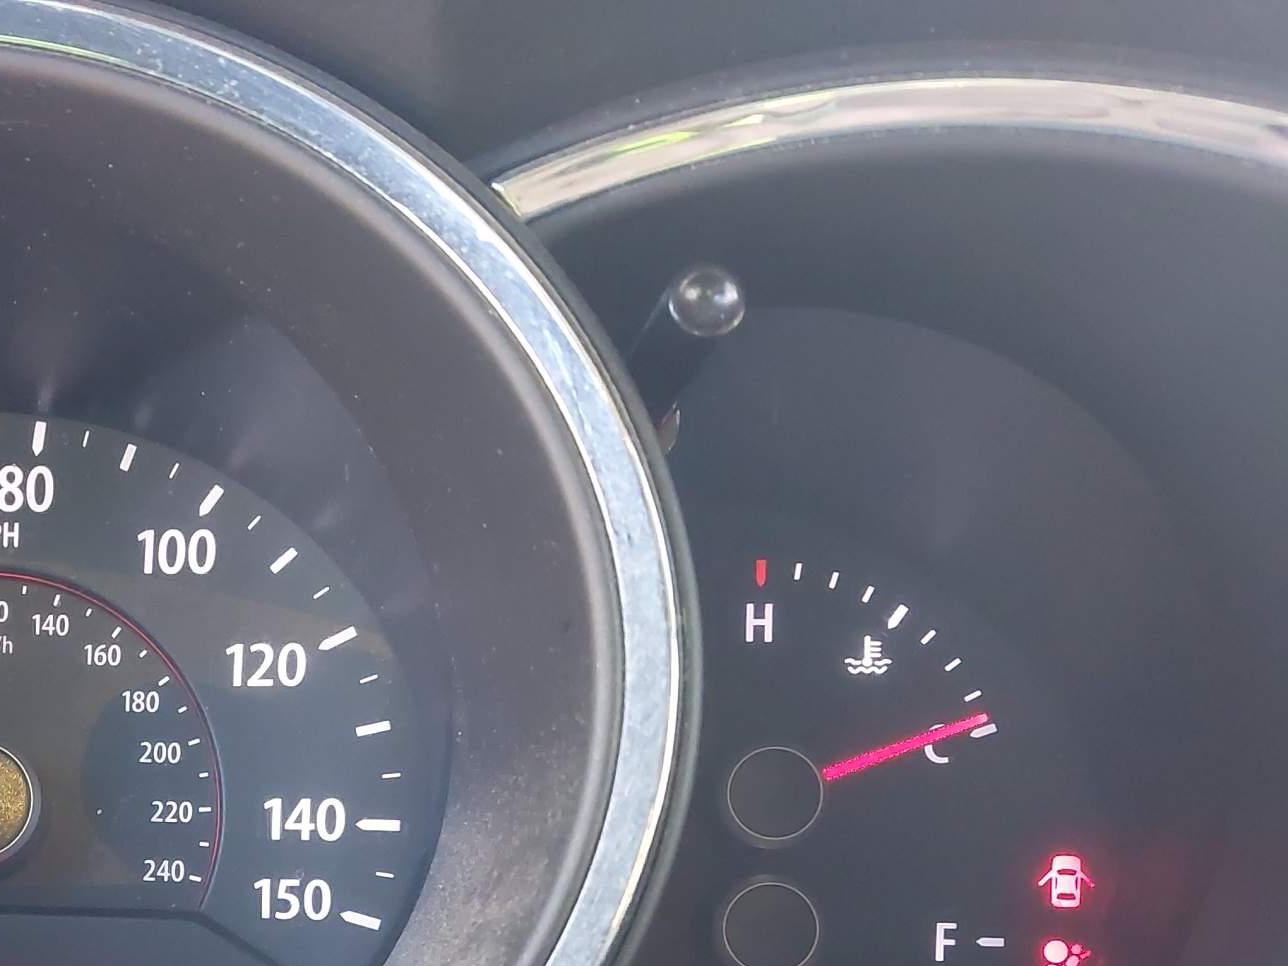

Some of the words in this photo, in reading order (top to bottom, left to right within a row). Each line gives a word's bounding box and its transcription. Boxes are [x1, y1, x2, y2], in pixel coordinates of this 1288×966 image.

[137, 529, 216, 575] 100
[32, 614, 69, 636] 140
[745, 603, 773, 643] H
[84, 645, 121, 666] 160
[226, 643, 306, 688] 120
[121, 691, 159, 712] 180
[138, 742, 181, 764] 200
[150, 802, 192, 823] 220
[263, 798, 345, 841] 140
[143, 860, 184, 882] 240
[254, 878, 331, 921] 150
[936, 922, 957, 961] F
